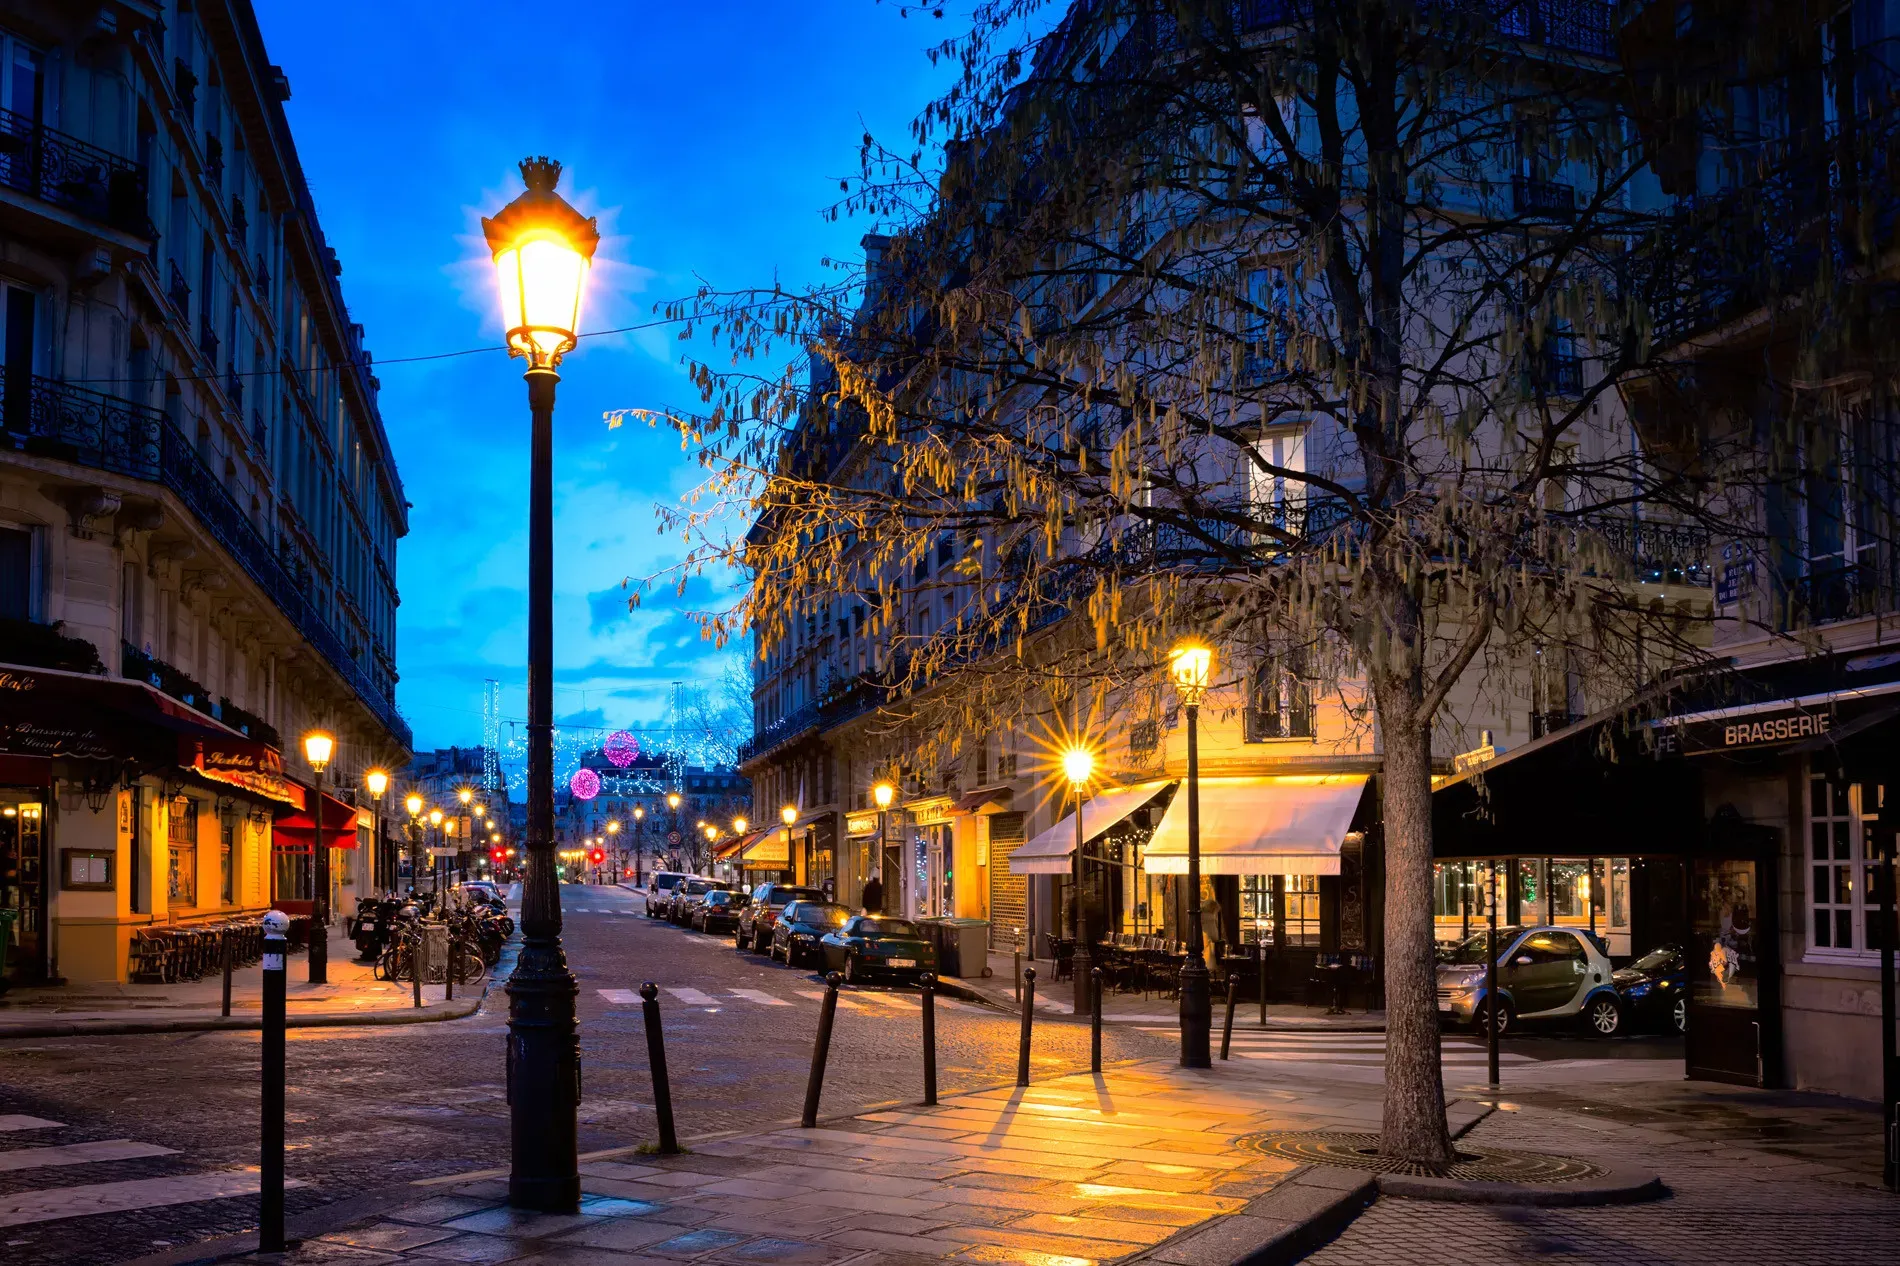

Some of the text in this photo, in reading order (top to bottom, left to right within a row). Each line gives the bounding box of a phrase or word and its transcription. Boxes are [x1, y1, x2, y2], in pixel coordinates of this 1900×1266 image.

[15, 722, 77, 738] Brasserie
[1725, 713, 1830, 745] BRASSERIE
[205, 751, 255, 767] Sorbets
